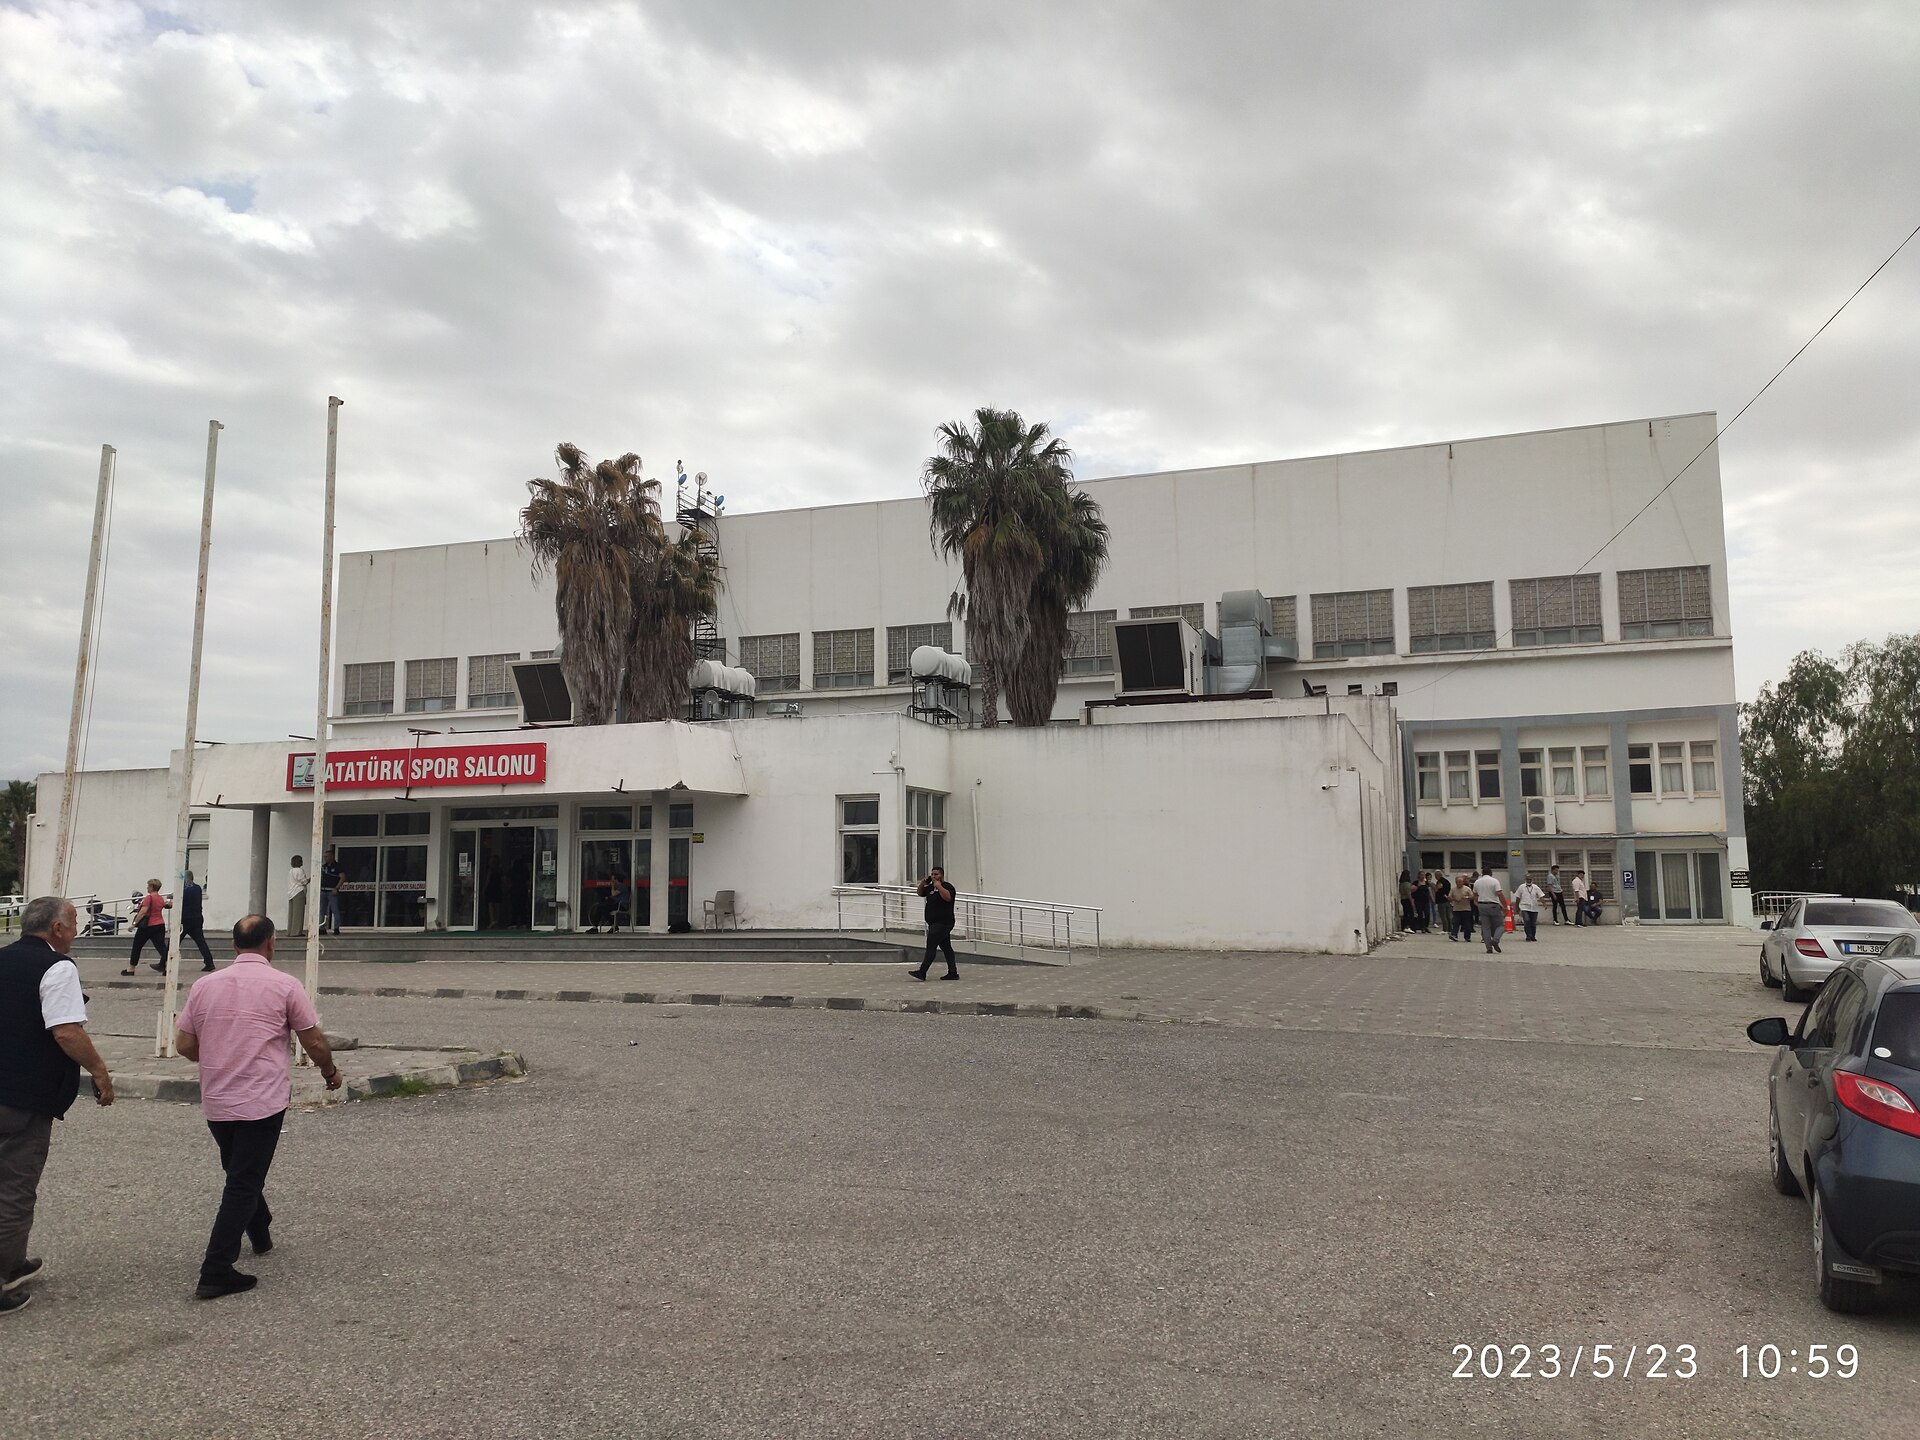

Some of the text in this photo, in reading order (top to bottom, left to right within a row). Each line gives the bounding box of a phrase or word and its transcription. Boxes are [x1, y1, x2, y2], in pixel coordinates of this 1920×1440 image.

[325, 754, 536, 782] ATATÜRK SPOR SALONU
[1624, 872, 1632, 882] P
